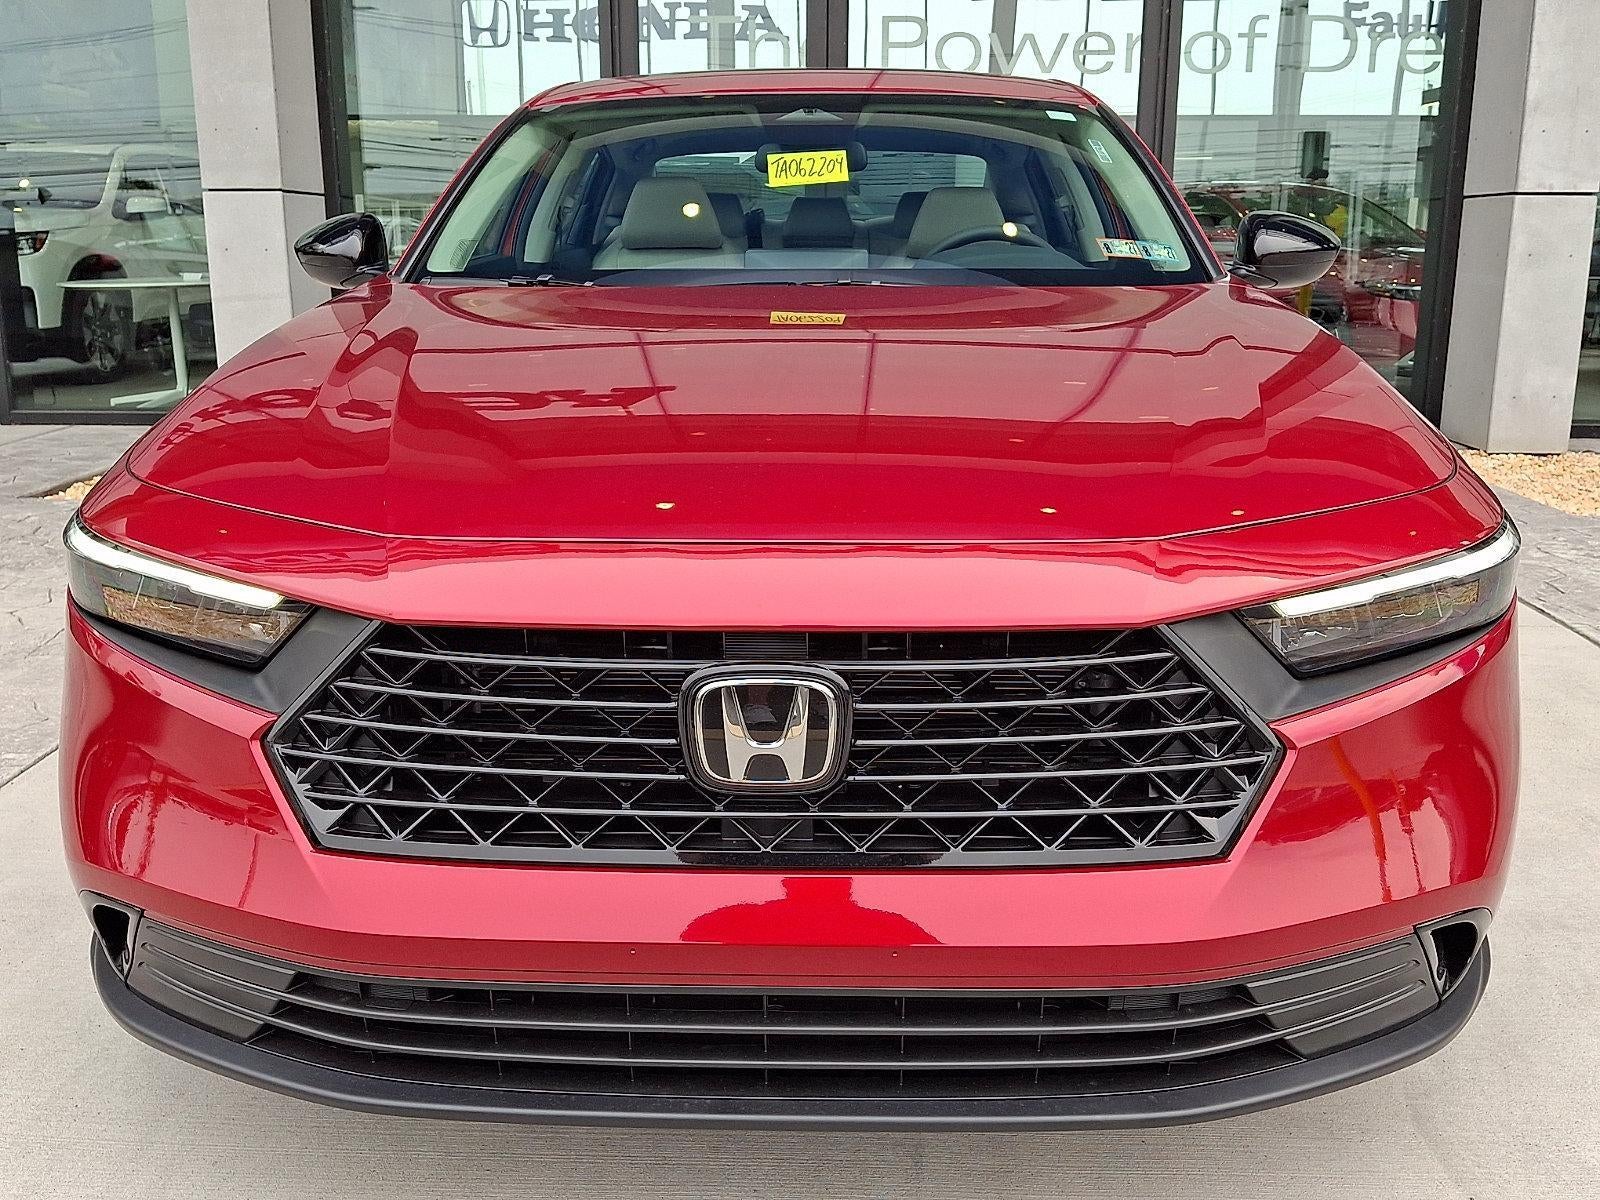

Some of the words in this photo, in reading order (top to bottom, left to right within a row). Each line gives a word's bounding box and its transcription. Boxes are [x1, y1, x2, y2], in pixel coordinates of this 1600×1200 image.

[688, 14, 807, 69] Th
[881, 15, 1141, 75] Power
[1184, 14, 1269, 74] of
[771, 156, 844, 179] TA062204
